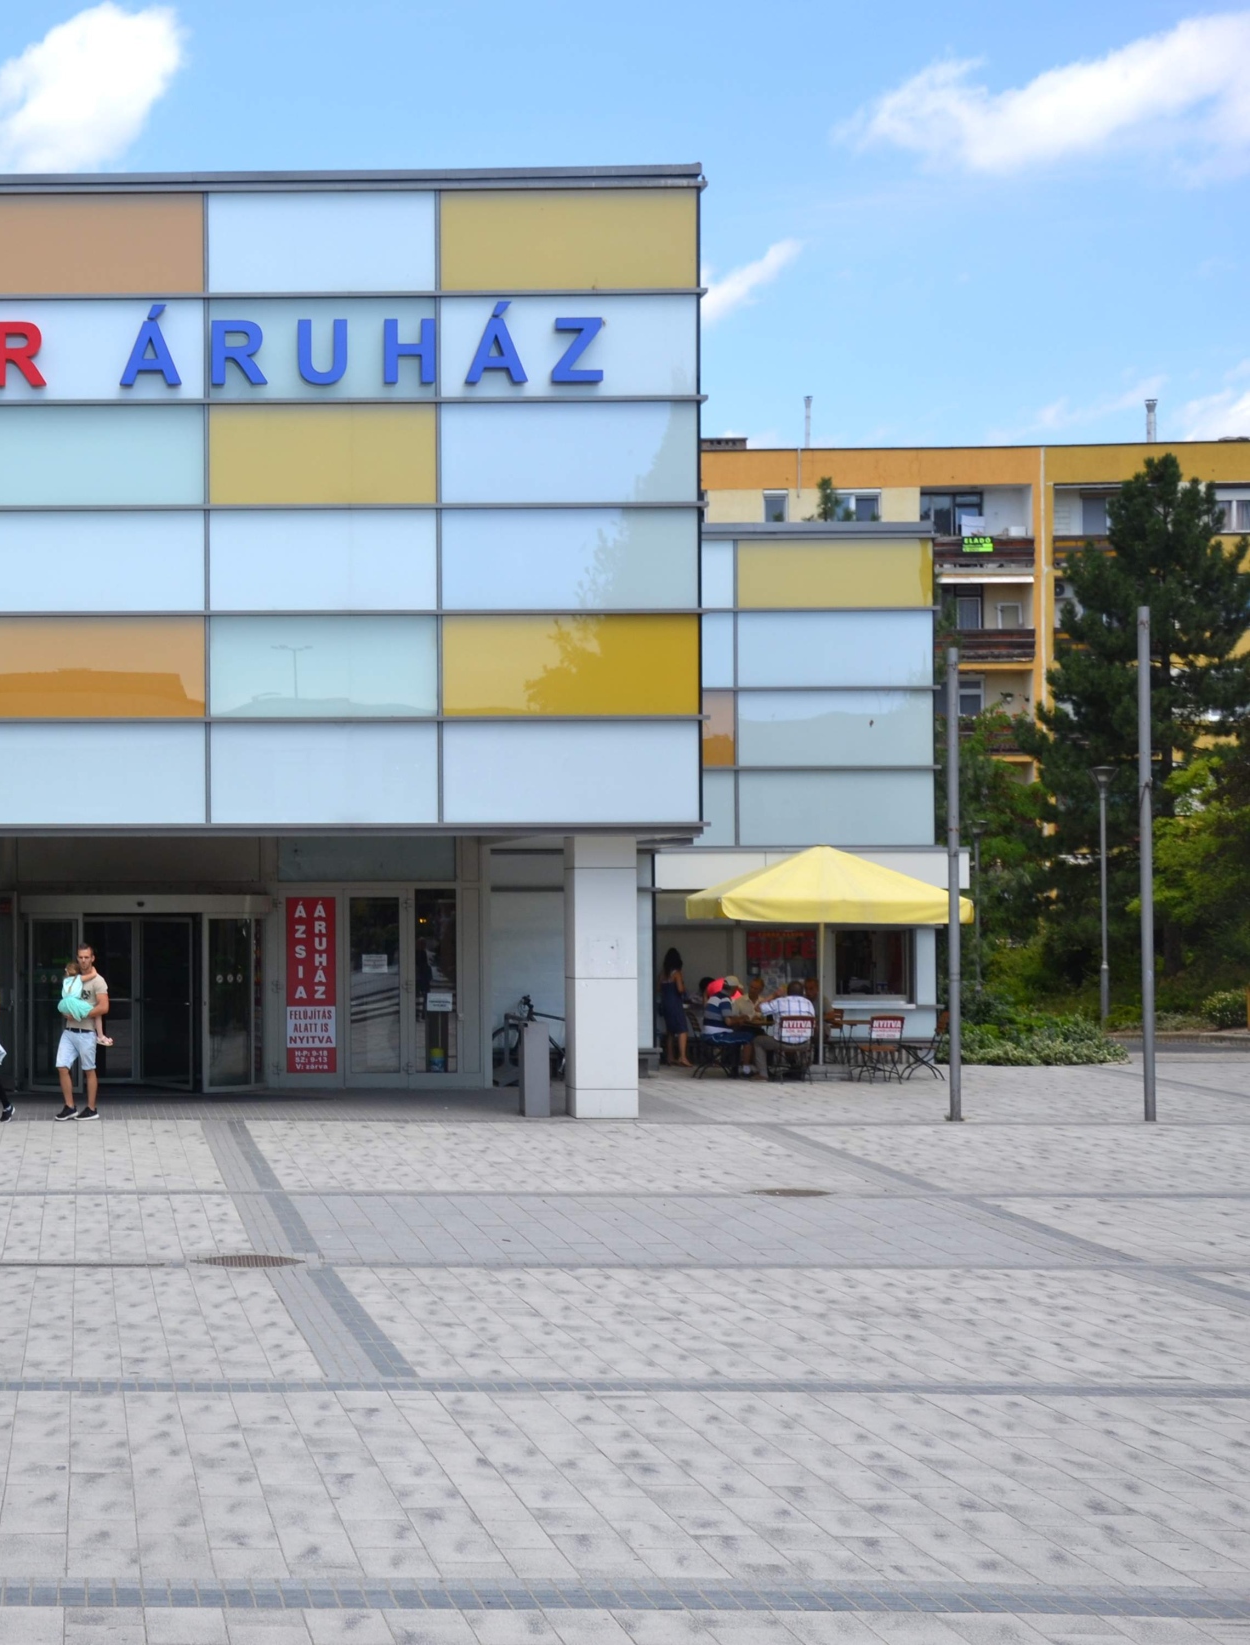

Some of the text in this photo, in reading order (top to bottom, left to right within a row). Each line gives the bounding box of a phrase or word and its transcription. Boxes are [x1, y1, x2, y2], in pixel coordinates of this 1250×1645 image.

[118, 301, 605, 387] ÁRUHÁZ
[313, 901, 327, 999] ÁRUHÁZ
[289, 1008, 332, 1020] FELÚJÍTÁS
[293, 1023, 329, 1033] ALATT IS
[782, 1019, 812, 1028] NYITVA
[872, 1019, 901, 1028] NYITVA
[289, 1035, 333, 1044] NYITVA
